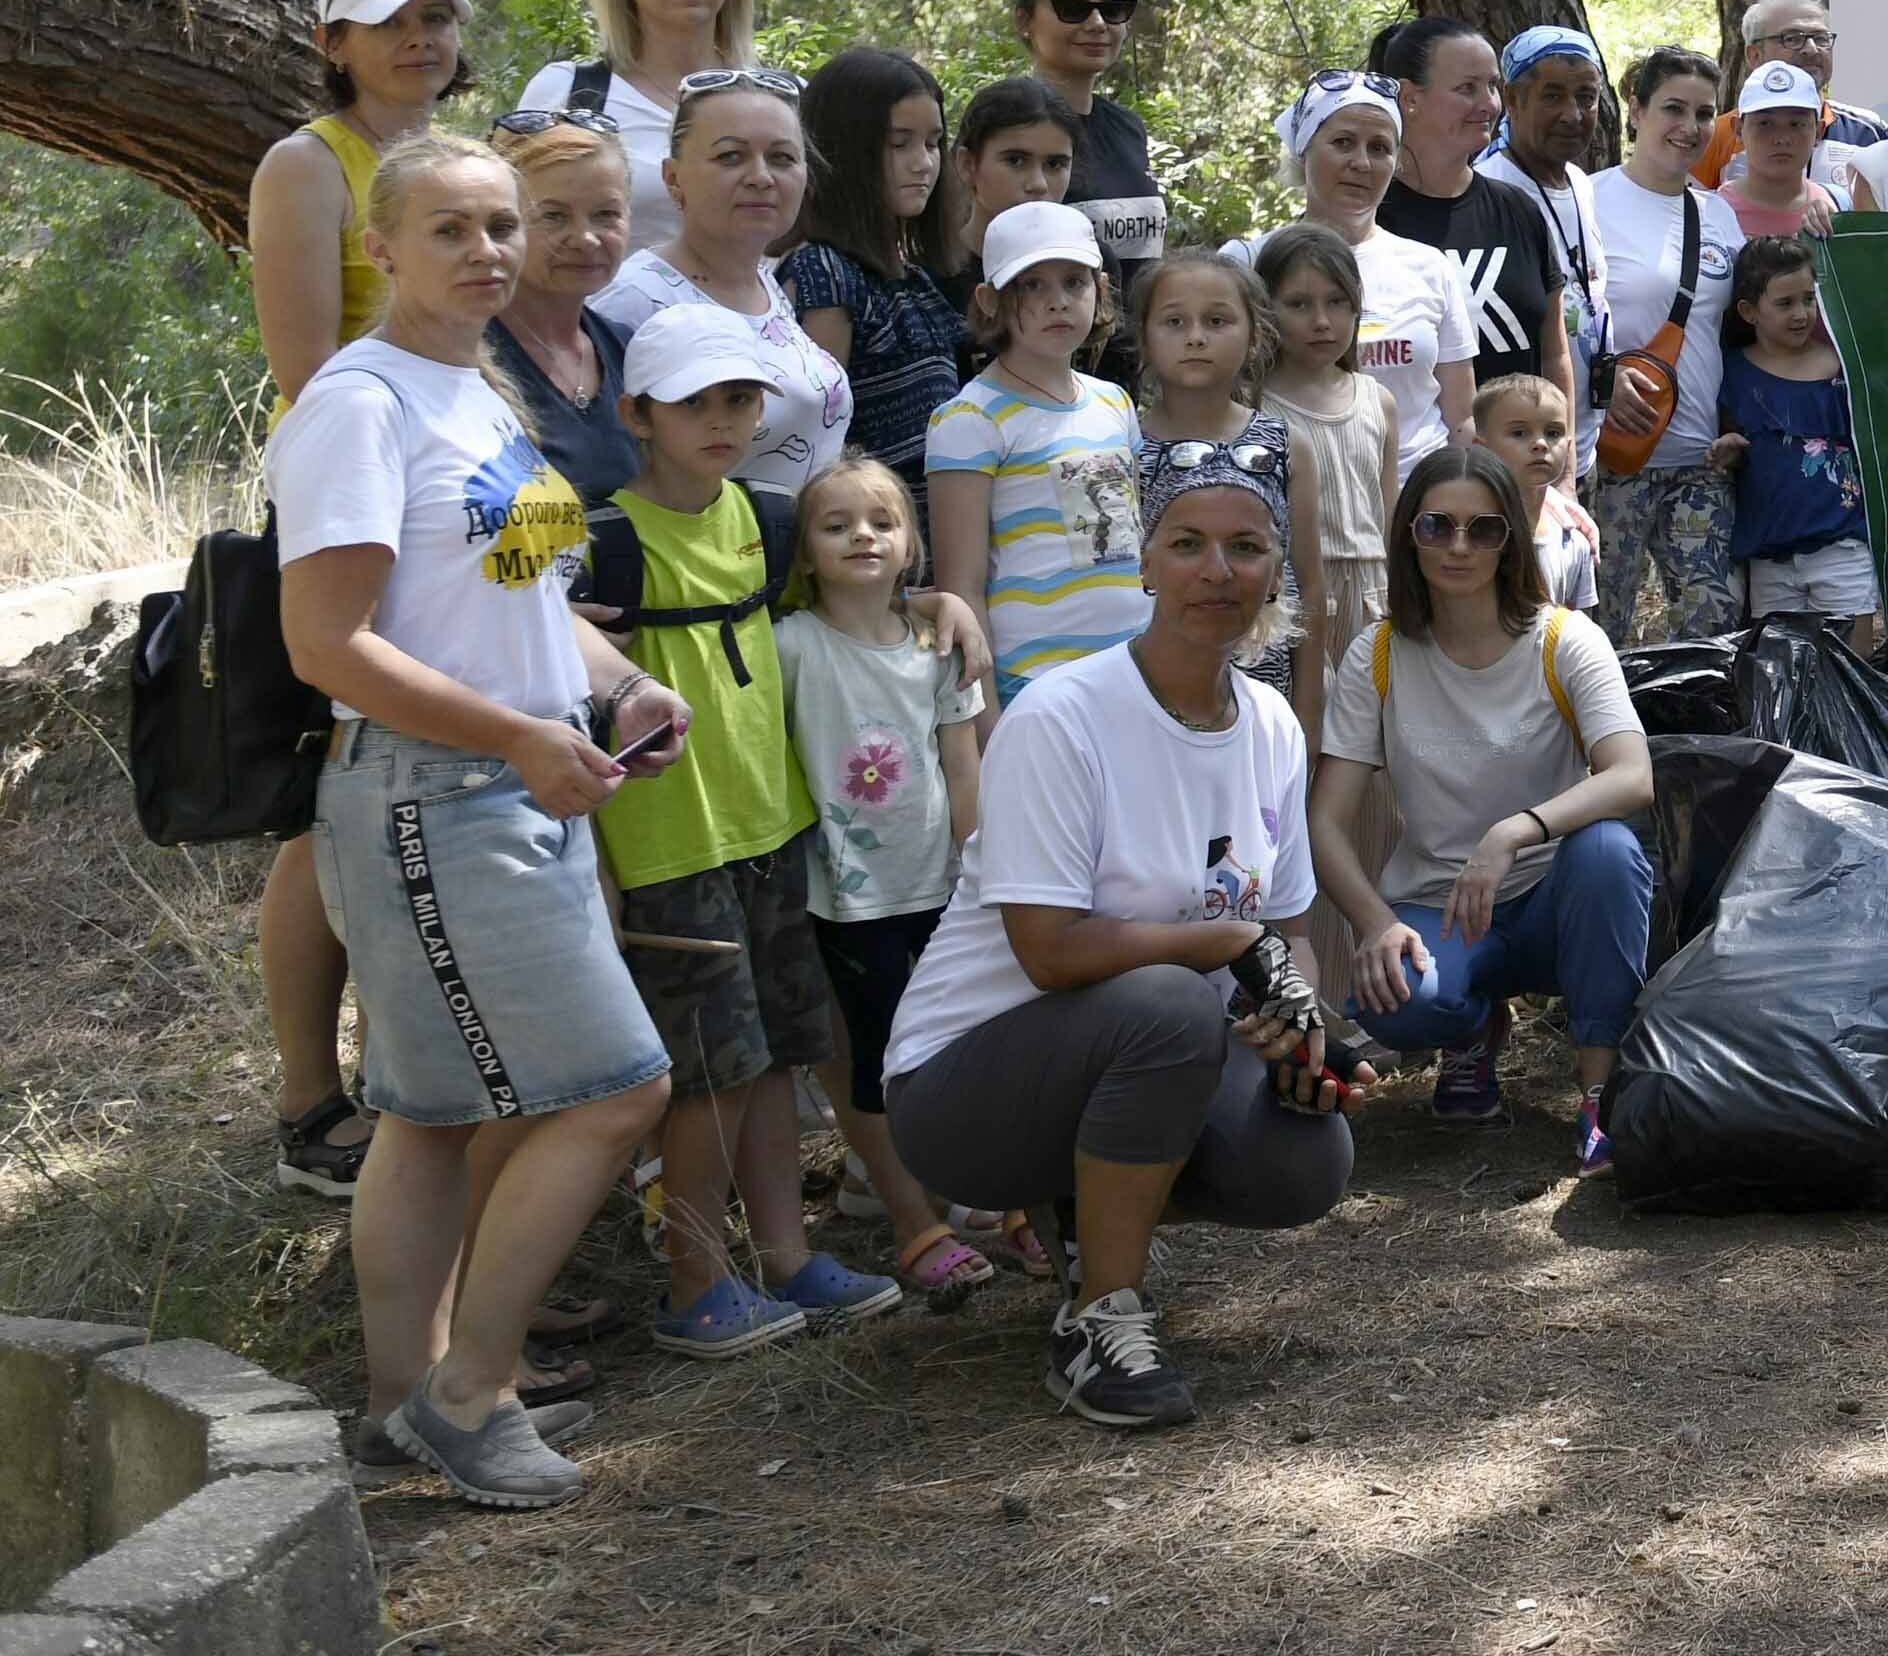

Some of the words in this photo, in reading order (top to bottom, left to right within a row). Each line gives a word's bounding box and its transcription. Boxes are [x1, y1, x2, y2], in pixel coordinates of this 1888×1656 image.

[1103, 216, 1156, 241] NORTH
[1361, 340, 1413, 367] AINE
[395, 804, 429, 880] PARIS
[412, 893, 453, 969] MILAN
[443, 979, 502, 1075] LONDON
[491, 1085, 519, 1117] PA
